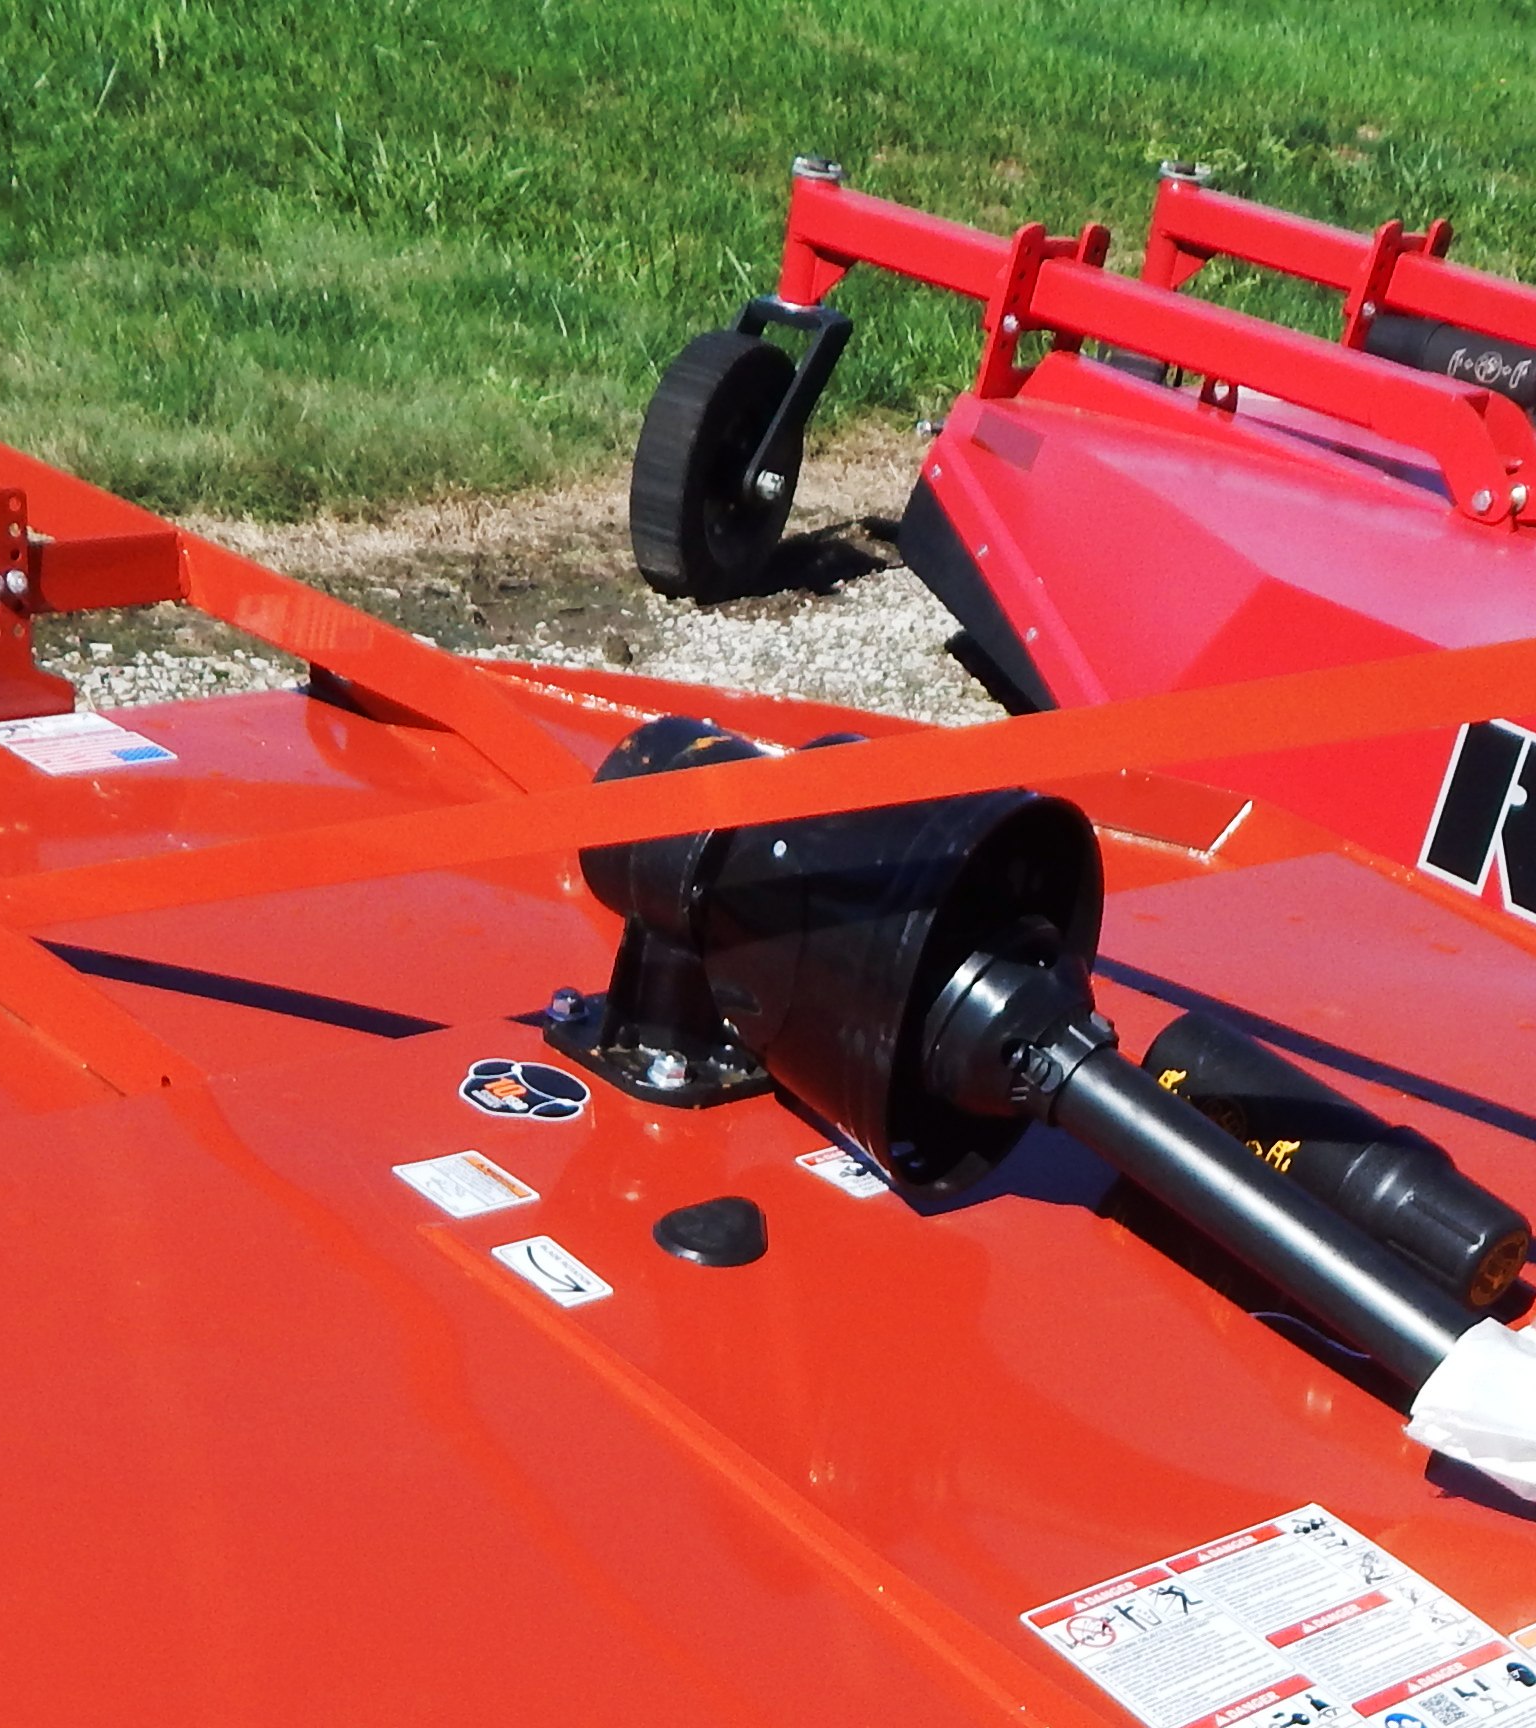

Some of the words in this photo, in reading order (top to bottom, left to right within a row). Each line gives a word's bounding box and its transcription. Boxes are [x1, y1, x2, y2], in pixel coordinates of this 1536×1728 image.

[1211, 1534, 1259, 1558] DANGER
[1084, 1581, 1138, 1608] DANGER
[1311, 1603, 1362, 1629] DANGER
[1416, 1662, 1467, 1688] DANGER
[1227, 1691, 1280, 1717] DANGER
